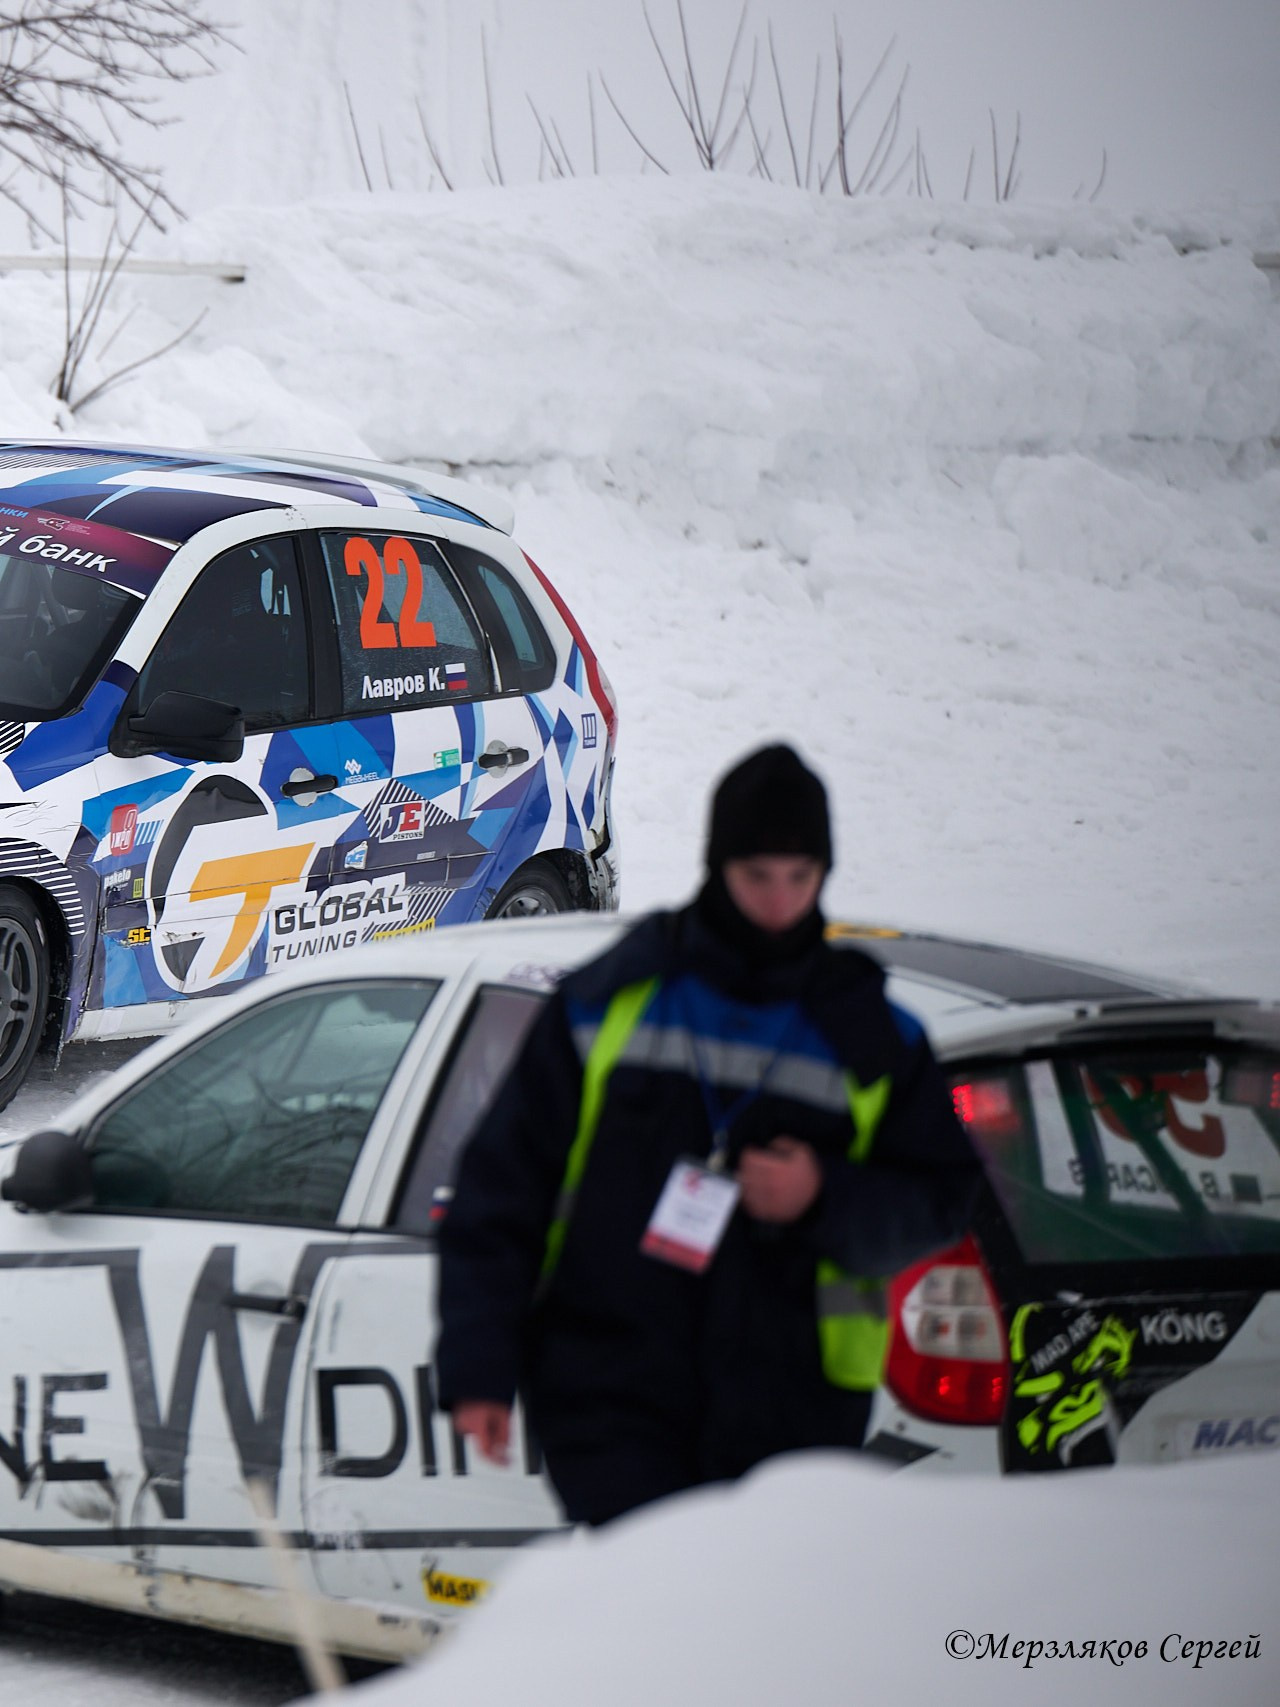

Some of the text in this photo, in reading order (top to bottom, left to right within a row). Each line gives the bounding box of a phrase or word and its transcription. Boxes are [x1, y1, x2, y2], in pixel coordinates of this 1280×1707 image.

[19, 534, 118, 573] банк
[344, 535, 437, 649] 22
[361, 667, 446, 700] Лавров К.
[381, 802, 423, 840] JE
[392, 831, 424, 841] PISTONS
[274, 884, 403, 935] GLOBAL
[272, 930, 357, 963] TUNING
[1140, 1306, 1228, 1346] KÖNG
[1029, 1332, 1071, 1374] MAD
